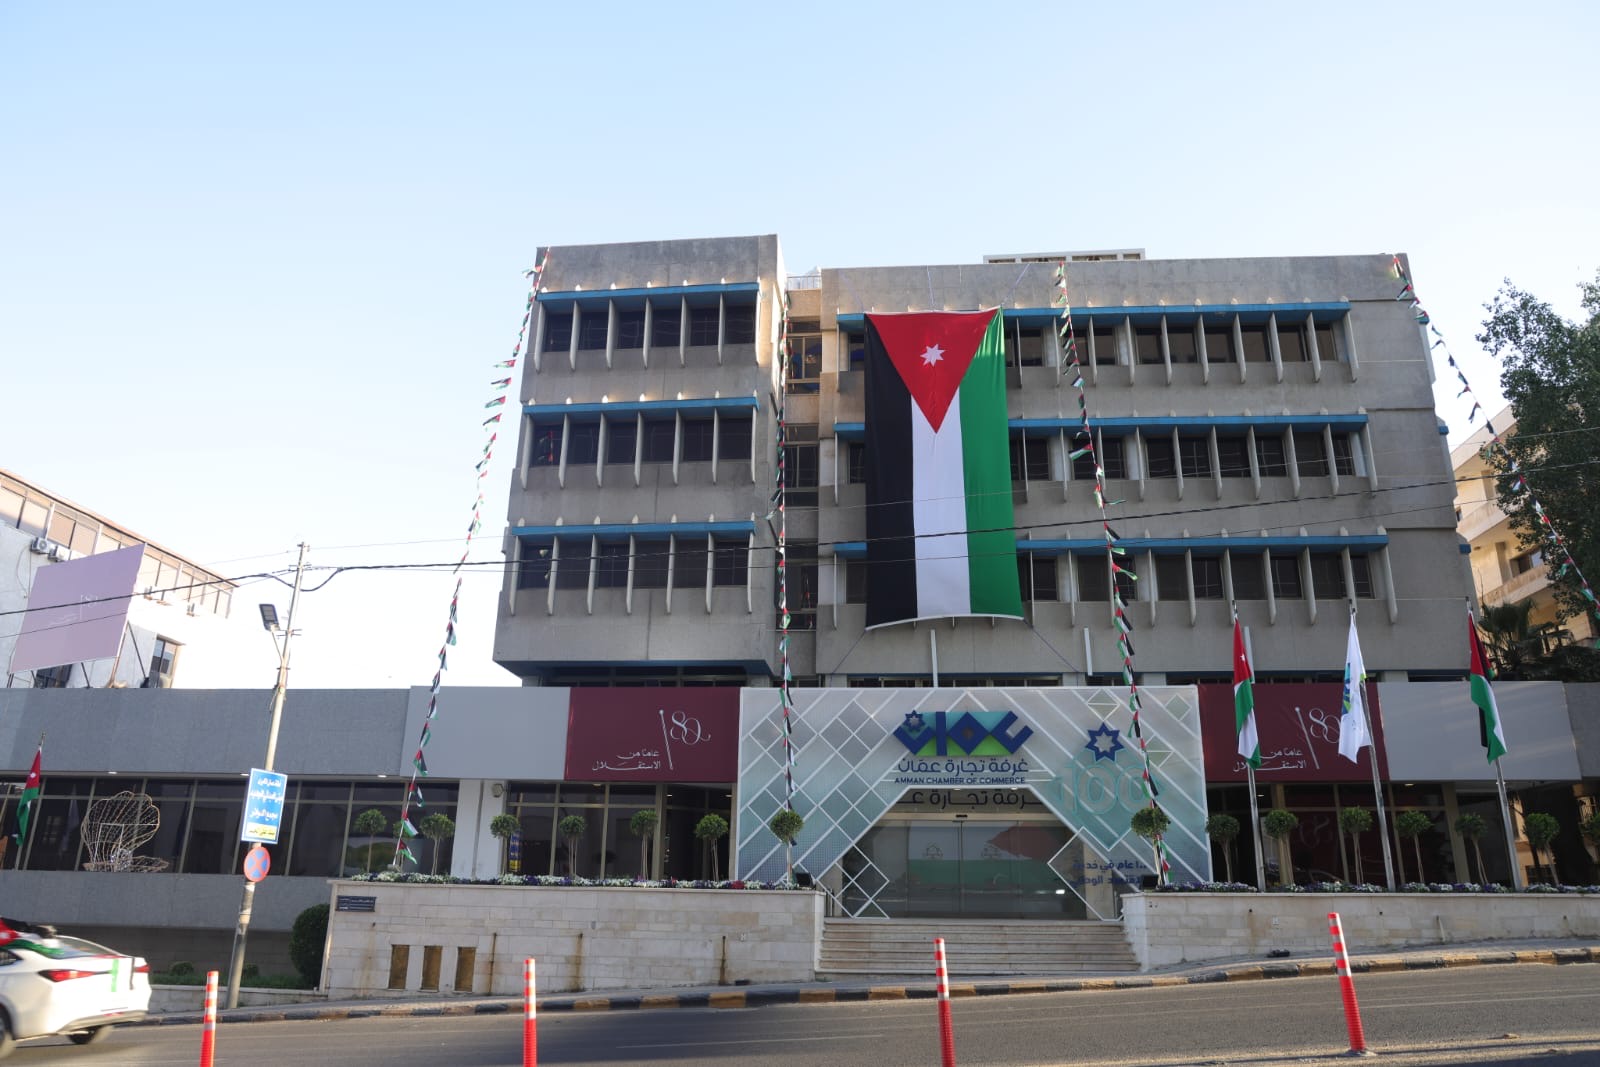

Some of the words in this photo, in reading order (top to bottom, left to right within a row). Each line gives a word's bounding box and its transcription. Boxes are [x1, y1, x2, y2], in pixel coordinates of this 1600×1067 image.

[944, 759, 986, 776] تجارة
[988, 758, 1029, 776] غرفة
[894, 777, 925, 785] AMMAN
[926, 777, 965, 785] CHAMBER
[966, 777, 978, 785] OF
[980, 777, 1026, 785] COMMERCE
[989, 788, 1043, 809] رفة
[1117, 859, 1133, 870] عام
